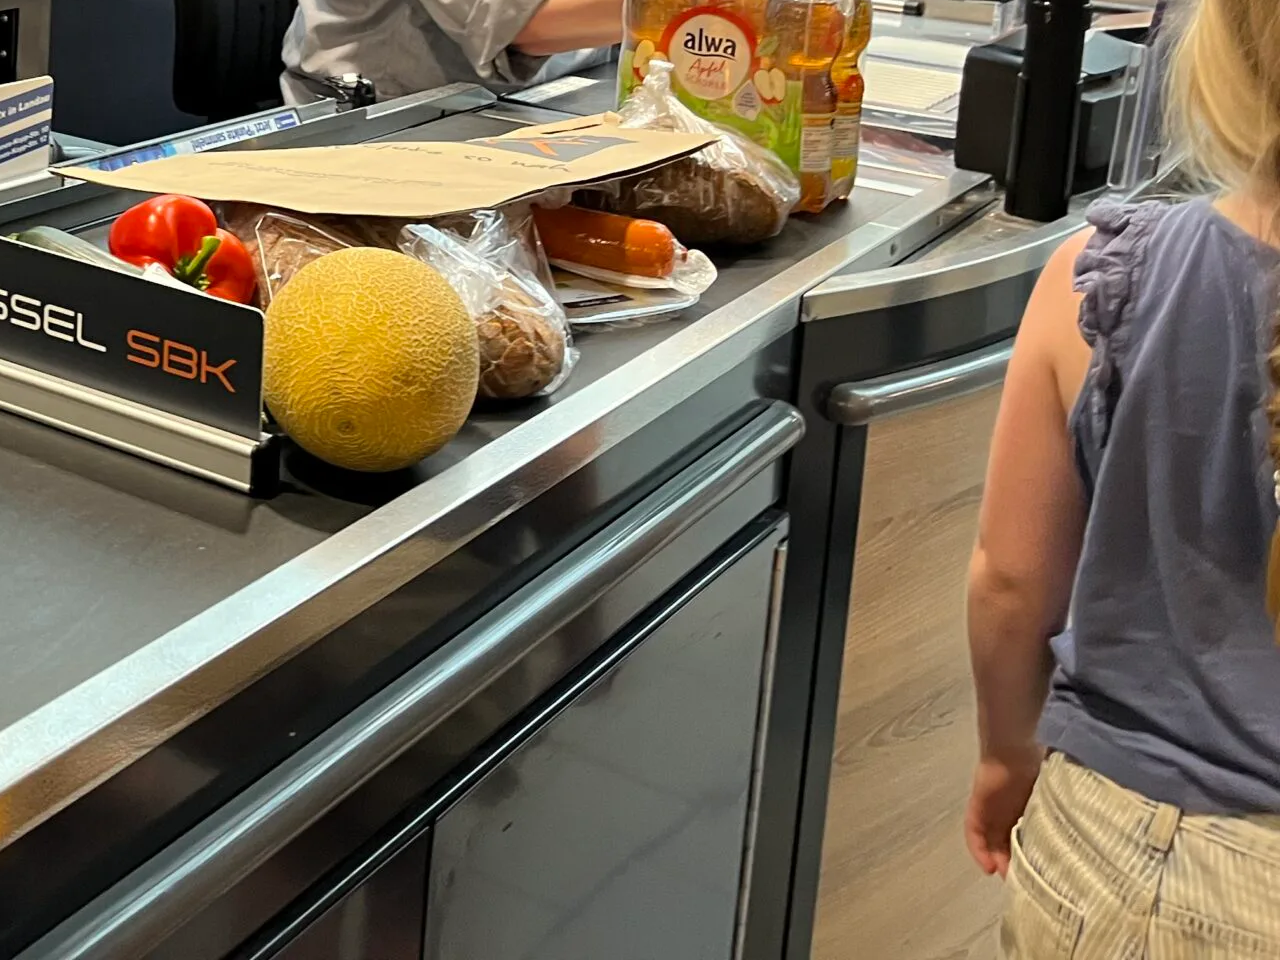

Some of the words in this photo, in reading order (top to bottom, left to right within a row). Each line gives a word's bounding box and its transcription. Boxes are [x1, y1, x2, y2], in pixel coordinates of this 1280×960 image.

[684, 28, 737, 58] alwa
[688, 58, 727, 78] Apfel
[8, 106, 17, 116] in
[18, 94, 51, 112] Landau
[254, 120, 272, 133] Jetzt
[126, 329, 237, 393] SBK
